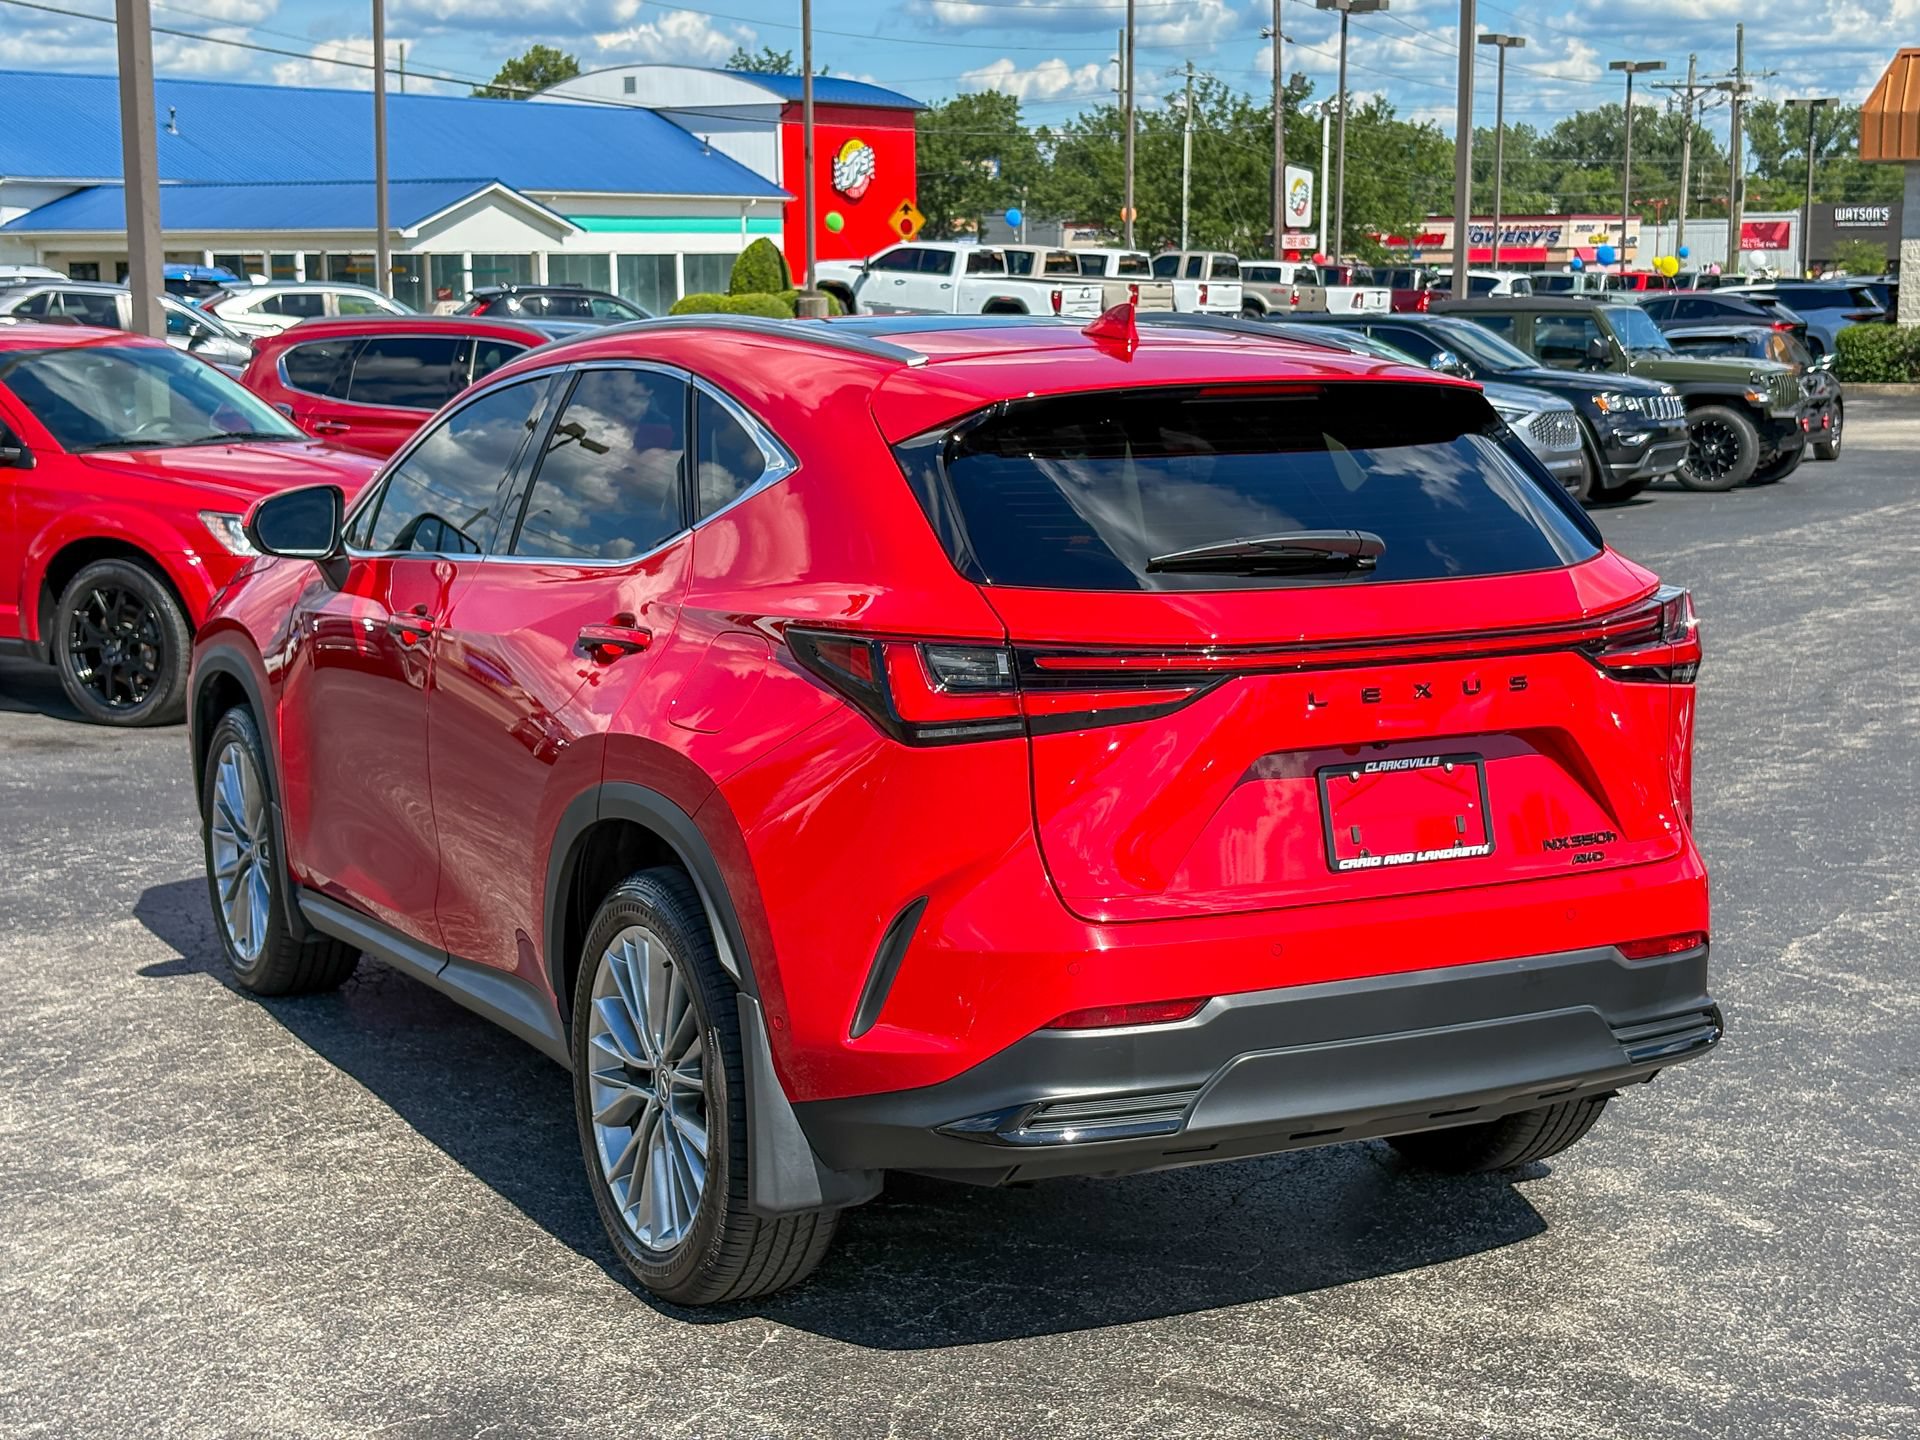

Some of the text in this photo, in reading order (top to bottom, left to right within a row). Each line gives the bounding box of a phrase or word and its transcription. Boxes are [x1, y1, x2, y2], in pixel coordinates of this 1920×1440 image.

[1834, 206, 1890, 221] WATSON'S
[1468, 230, 1562, 244] OWERY'S
[1307, 675, 1528, 708] LEXUS
[1364, 756, 1440, 773] CLARKSVILLE
[1338, 843, 1490, 870] CRAIG AND LANDRETH
